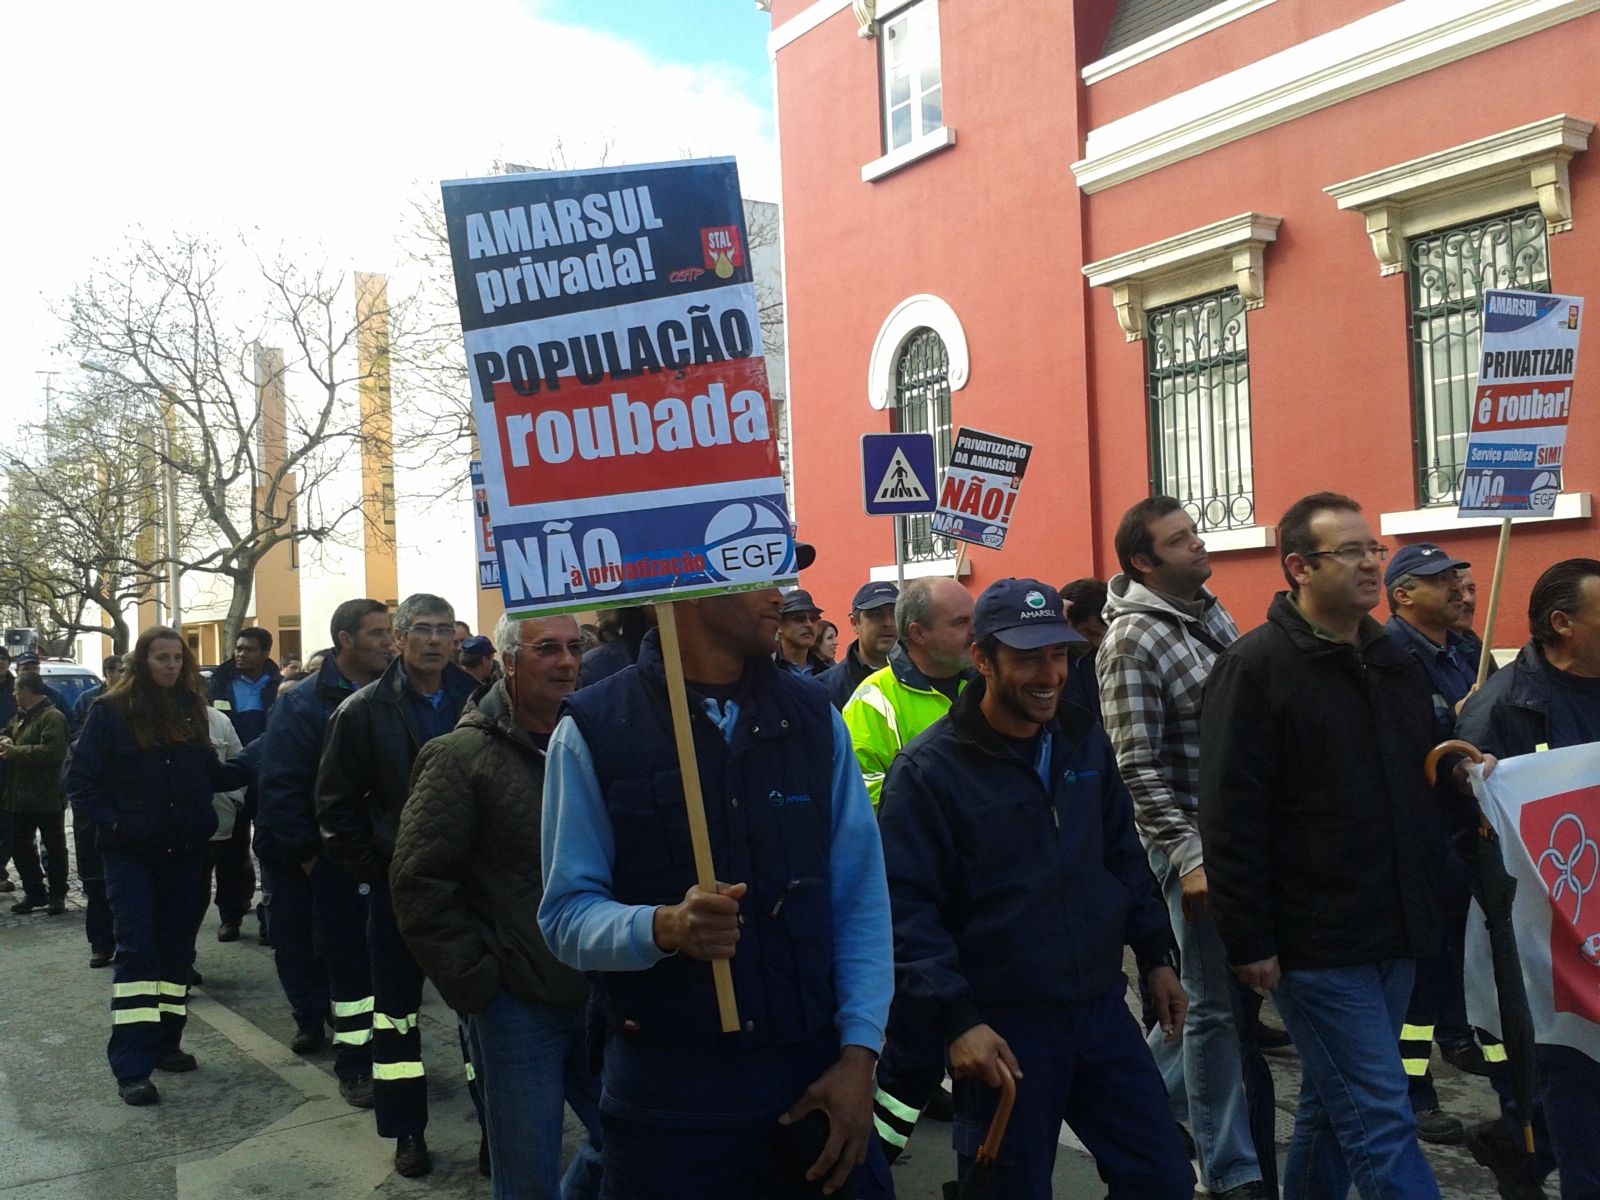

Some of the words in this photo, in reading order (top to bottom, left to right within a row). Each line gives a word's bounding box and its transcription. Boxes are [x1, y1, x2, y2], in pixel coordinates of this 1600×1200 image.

[466, 186, 663, 260] AMARSUL
[708, 231, 732, 249] STAL
[475, 236, 657, 313] privada!
[1489, 296, 1538, 317] AMARSUL
[473, 304, 754, 403] POPULAÇÃO
[1483, 348, 1574, 379] PRIVATIZAR
[1478, 390, 1492, 424] é
[1497, 387, 1570, 423] roubar!
[505, 383, 771, 468] roubada
[954, 452, 968, 465] DA
[971, 456, 1017, 473] AMARSUL
[958, 437, 1026, 459] PRIVATIZAÇÃO
[1471, 447, 1502, 463] Serviço
[1503, 446, 1534, 463] público
[1537, 446, 1562, 465] SIM!
[939, 475, 1017, 524] NÃO!
[1462, 469, 1505, 508] NÃO
[1534, 493, 1555, 506] EGF
[933, 514, 964, 535] NÃO
[985, 535, 1002, 545] EGF
[502, 519, 623, 602] NÃO
[570, 565, 582, 586] à
[588, 551, 705, 586] privatização
[721, 541, 783, 571] EGF
[481, 561, 501, 584] NÃ
[1020, 609, 1056, 620] AMARSUL
